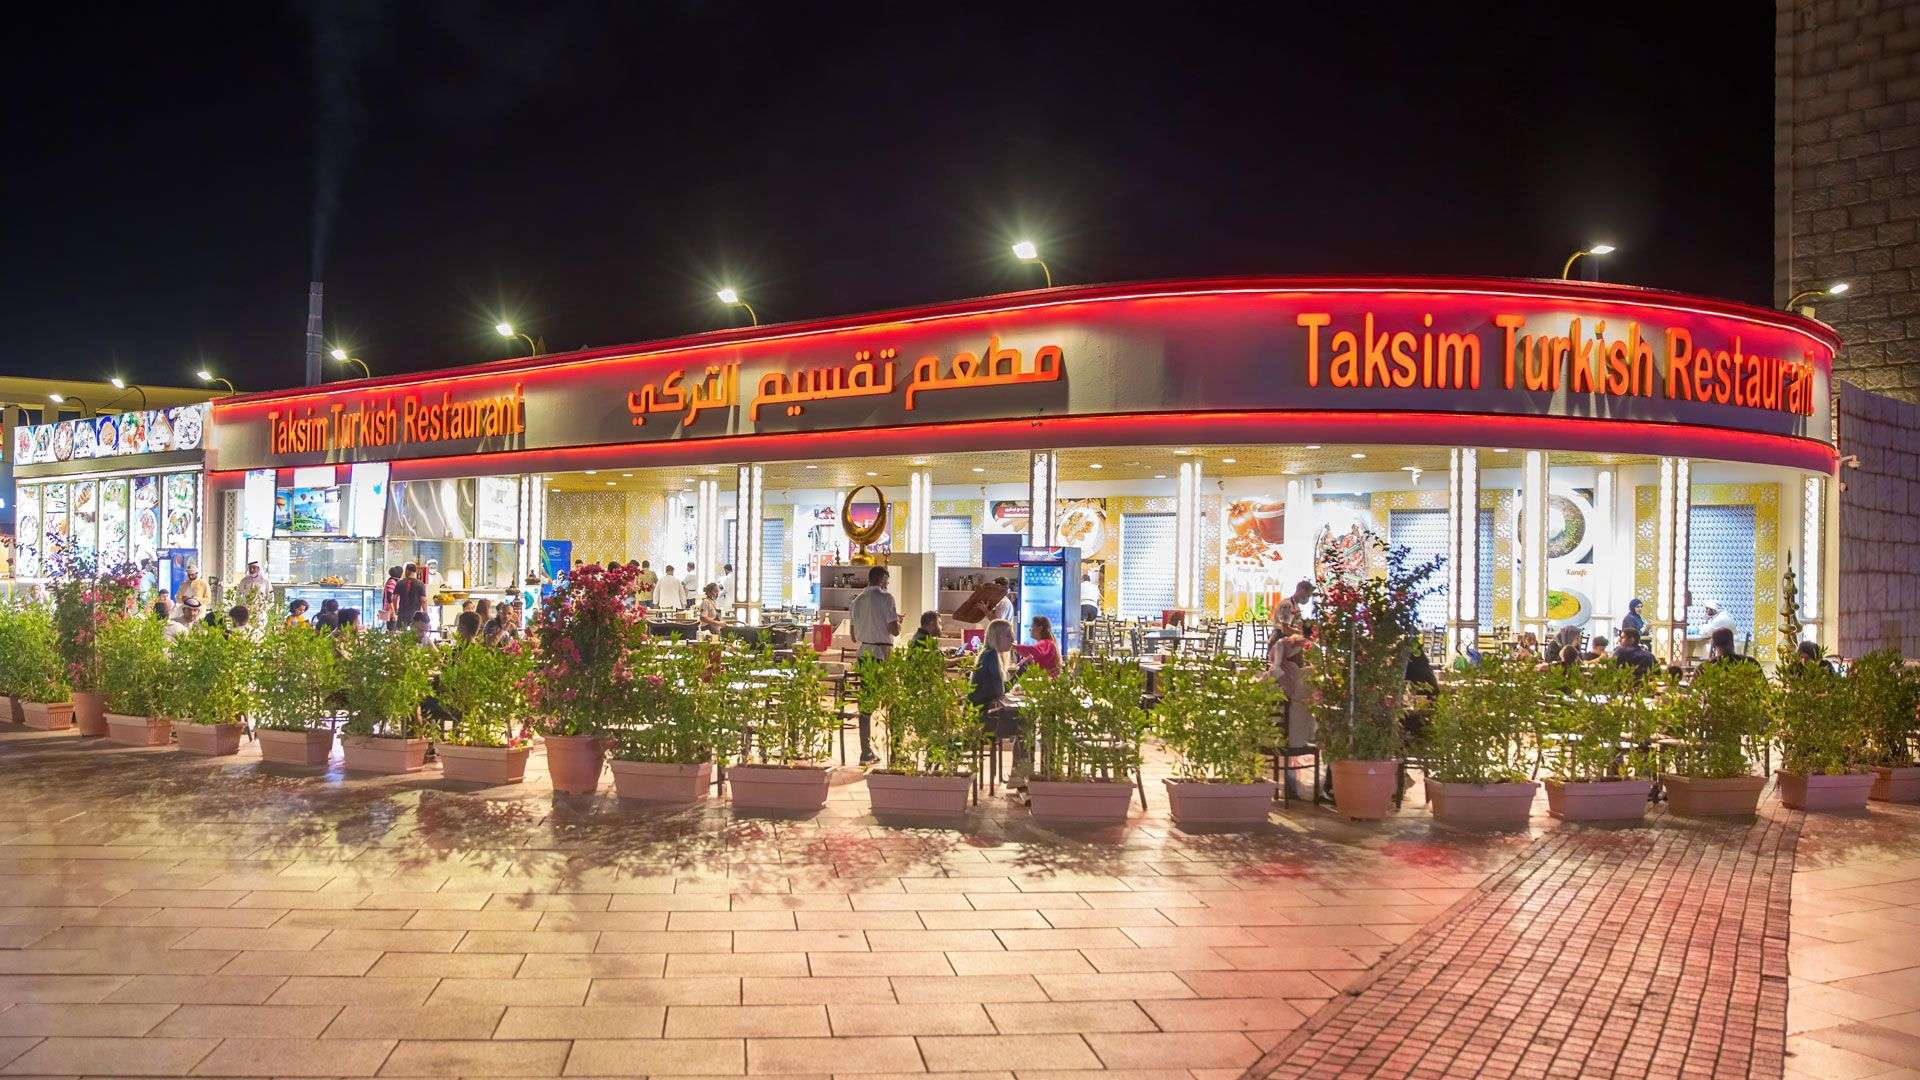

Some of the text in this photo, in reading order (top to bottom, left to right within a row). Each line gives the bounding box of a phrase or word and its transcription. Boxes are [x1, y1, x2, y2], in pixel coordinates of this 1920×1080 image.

[627, 336, 1063, 427] مطعم تقسيم التركي
[1297, 312, 1814, 417] Taksim Turkish Restaurant
[268, 382, 526, 455] Taksim Turkish Restaurant
